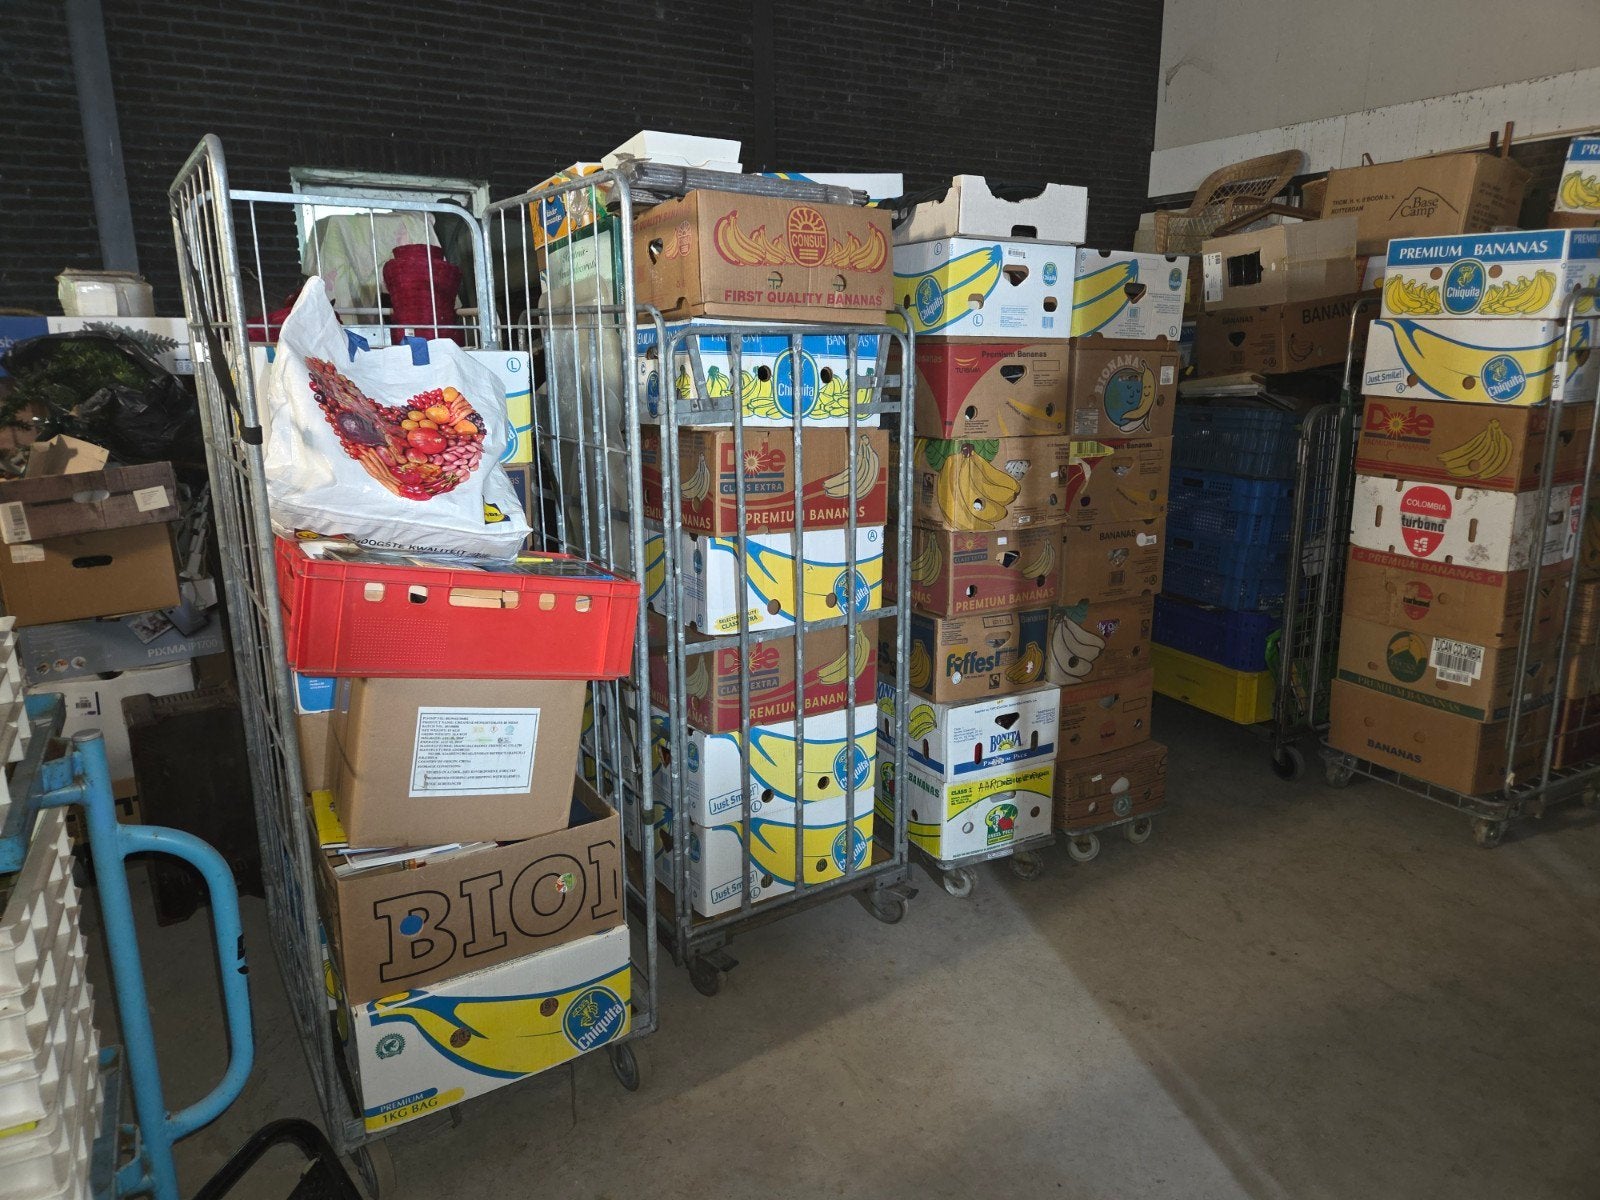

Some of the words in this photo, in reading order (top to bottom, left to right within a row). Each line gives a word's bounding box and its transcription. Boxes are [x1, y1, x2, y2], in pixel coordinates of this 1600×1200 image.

[1413, 196, 1439, 209] Base
[1400, 205, 1435, 218] Camp
[791, 233, 827, 249] CONSUL
[1399, 244, 1463, 260] PREMIUM
[1473, 239, 1549, 256] BANANAS
[724, 289, 763, 303] FIRST
[767, 290, 824, 305] QUALITY
[826, 292, 884, 307] BANANAS
[1446, 286, 1481, 300] Chiquita
[1017, 350, 1048, 358] Bananas
[1366, 374, 1381, 384] Just
[1487, 373, 1526, 398] Chiquita
[754, 482, 783, 492] EXTRA
[1405, 497, 1447, 512] COLOMBIA
[1400, 514, 1446, 533] turbana
[1099, 528, 1137, 541] BANANAS
[407, 543, 467, 558] KWALITEIT
[1367, 553, 1418, 570] PREMIUM
[1420, 561, 1484, 582] BANANAS
[955, 595, 1007, 613] PREMIUM
[1008, 587, 1055, 604] BANANAS
[147, 644, 188, 659] PIXMA
[750, 679, 778, 690] EXTRA
[989, 729, 1023, 753] BONITA
[1366, 738, 1423, 764] BANANAS
[713, 799, 730, 813] Just
[714, 887, 731, 902] Just
[577, 1003, 624, 1050] Chiquita
[379, 1093, 424, 1114] PREMIUM
[383, 1108, 408, 1124] 1KG
[411, 1097, 439, 1114] BAG
